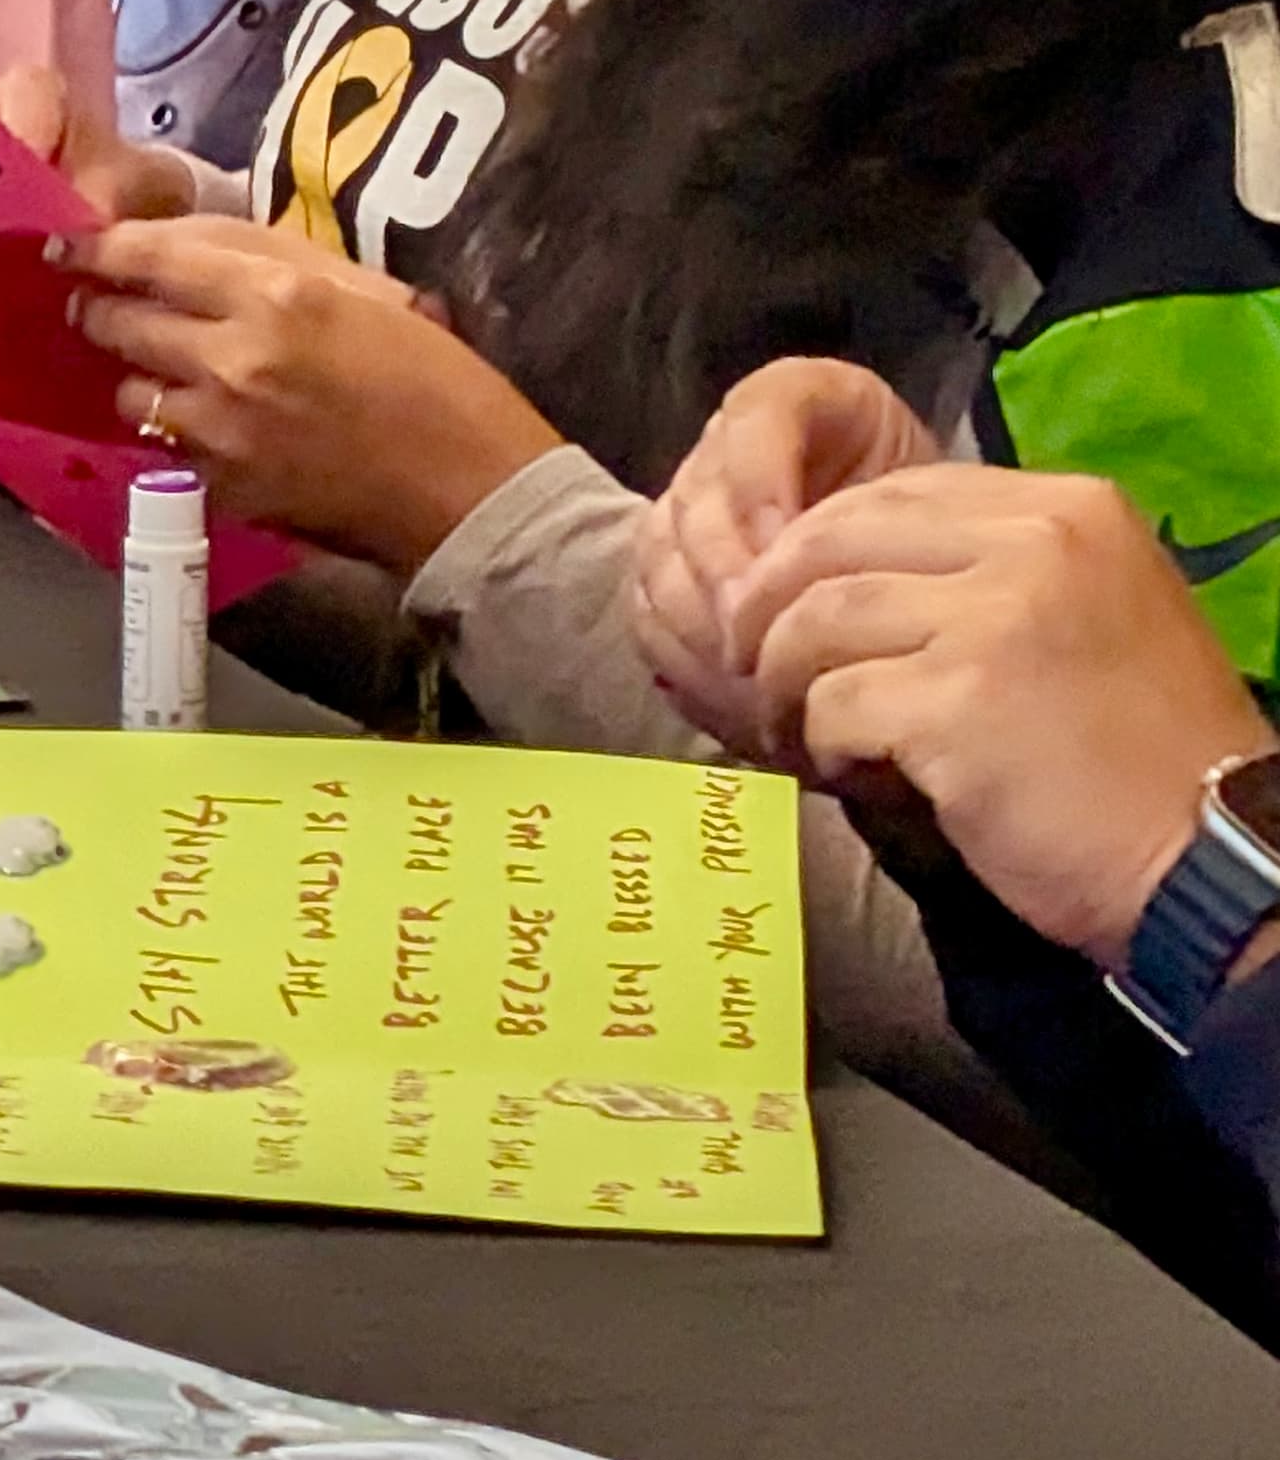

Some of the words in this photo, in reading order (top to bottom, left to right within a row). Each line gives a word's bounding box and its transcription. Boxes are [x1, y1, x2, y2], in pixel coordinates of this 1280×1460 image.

[302, 811, 350, 832] IS
[312, 780, 351, 798] A
[505, 803, 553, 850] HAS
[695, 770, 752, 874] PRESENCE
[137, 794, 283, 928] STRONG
[404, 793, 453, 872] PLACE
[294, 850, 344, 939] WORLD
[505, 863, 545, 884] IT
[606, 827, 653, 934] BLESSED
[381, 897, 454, 1028] BETTER
[706, 901, 773, 962] YOUR
[130, 950, 221, 1034] STAY
[279, 949, 328, 1017] THE
[495, 904, 556, 1037] BECAUSE
[600, 962, 662, 1038] BEEN
[719, 974, 758, 1050] WITH
